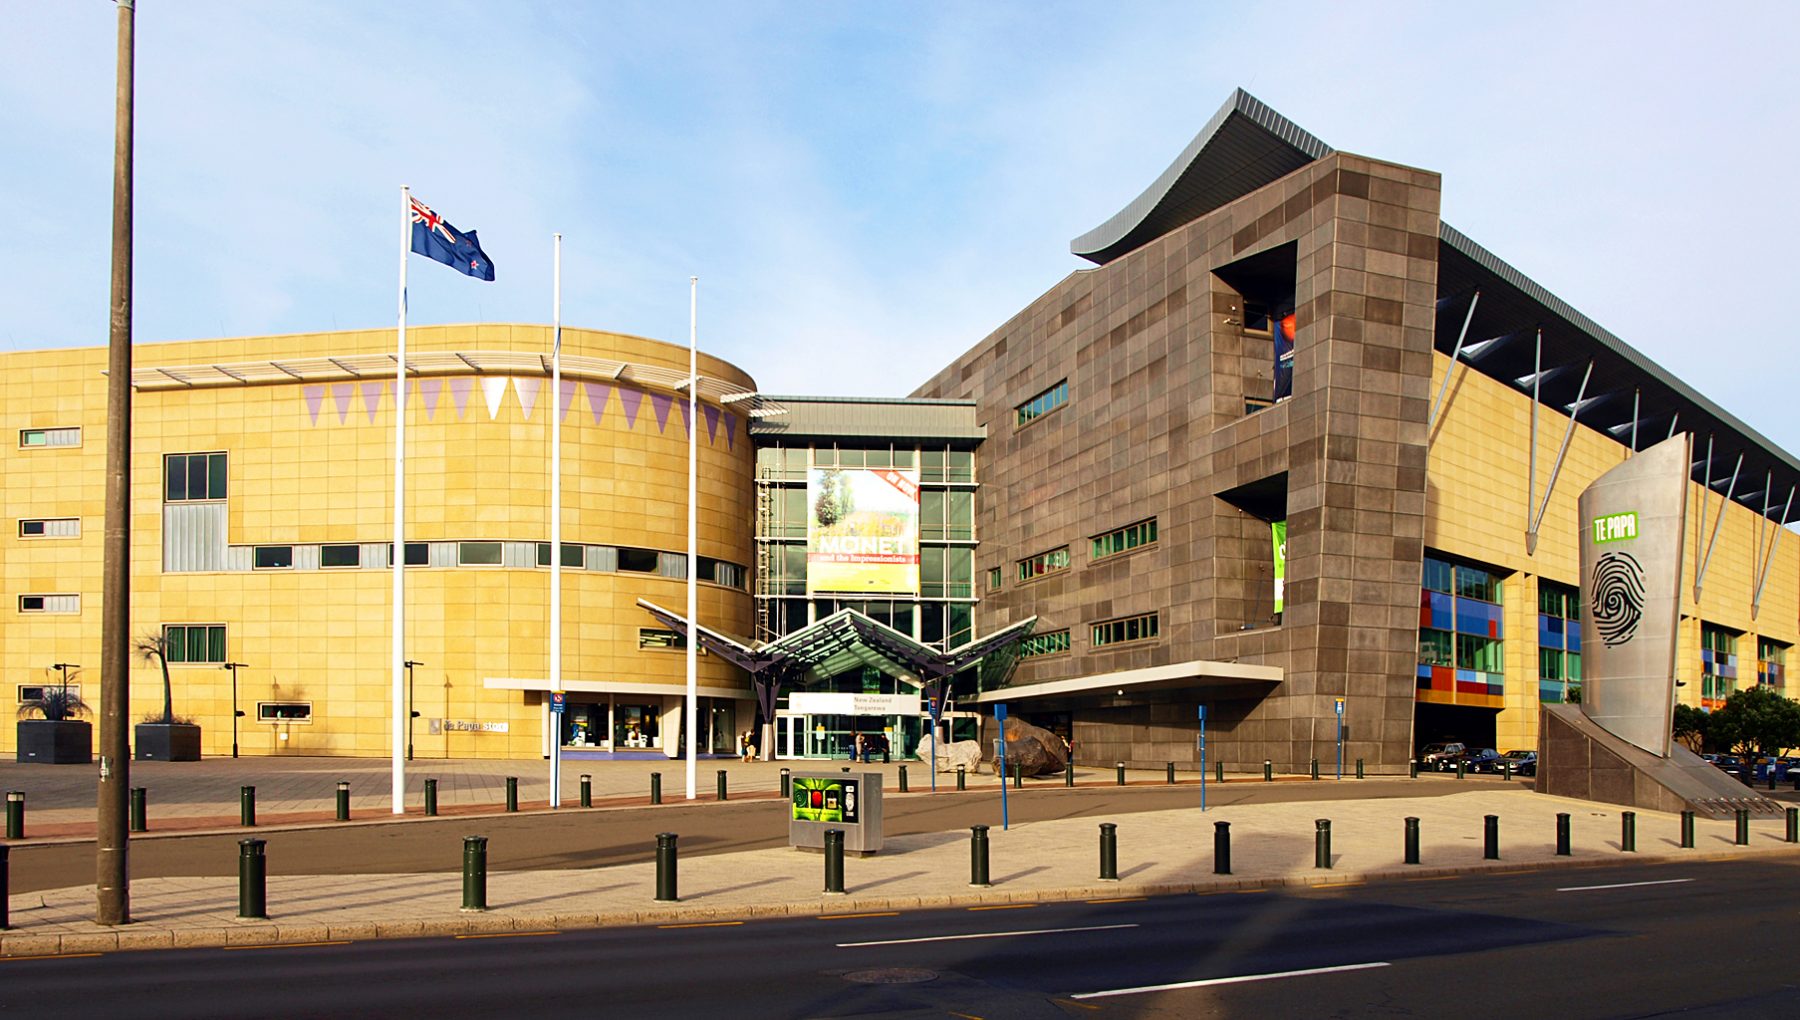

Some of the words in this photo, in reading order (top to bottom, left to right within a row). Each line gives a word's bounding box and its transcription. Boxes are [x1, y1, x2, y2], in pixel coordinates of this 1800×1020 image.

[1594, 519, 1606, 541] TE
[1607, 514, 1636, 539] PAPA
[819, 536, 906, 554] MONET
[850, 555, 906, 563] Impressionists
[457, 721, 481, 731] Papa
[483, 722, 509, 732] store
